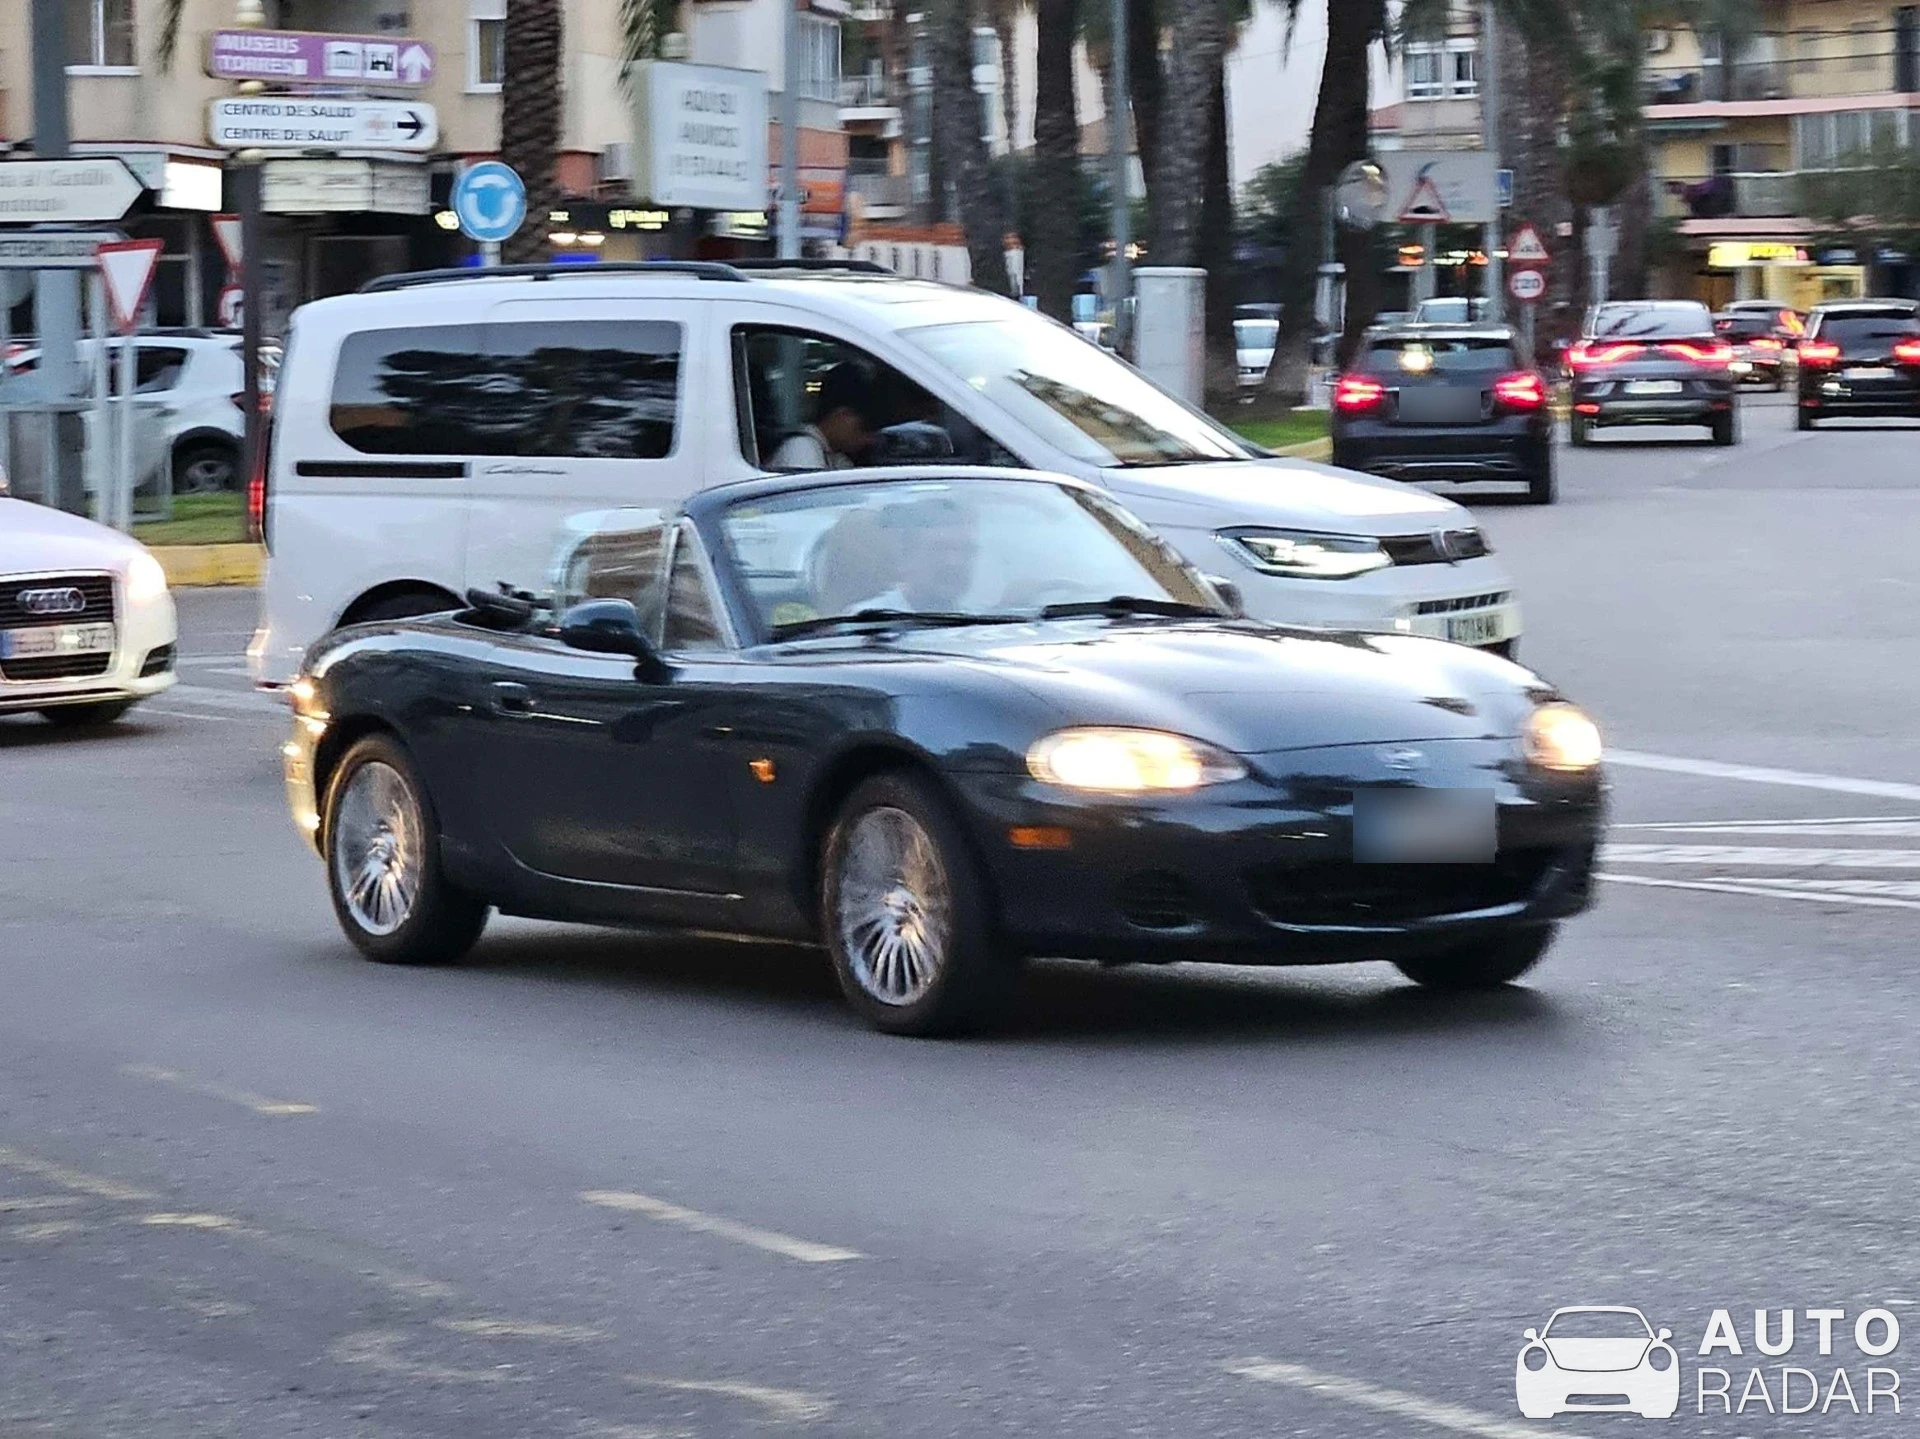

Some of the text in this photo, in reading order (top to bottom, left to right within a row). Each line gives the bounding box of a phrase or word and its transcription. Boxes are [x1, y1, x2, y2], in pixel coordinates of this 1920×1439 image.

[224, 103, 356, 118] CENTRO DE SALUD
[224, 127, 353, 142] CENTRE DE SALUT
